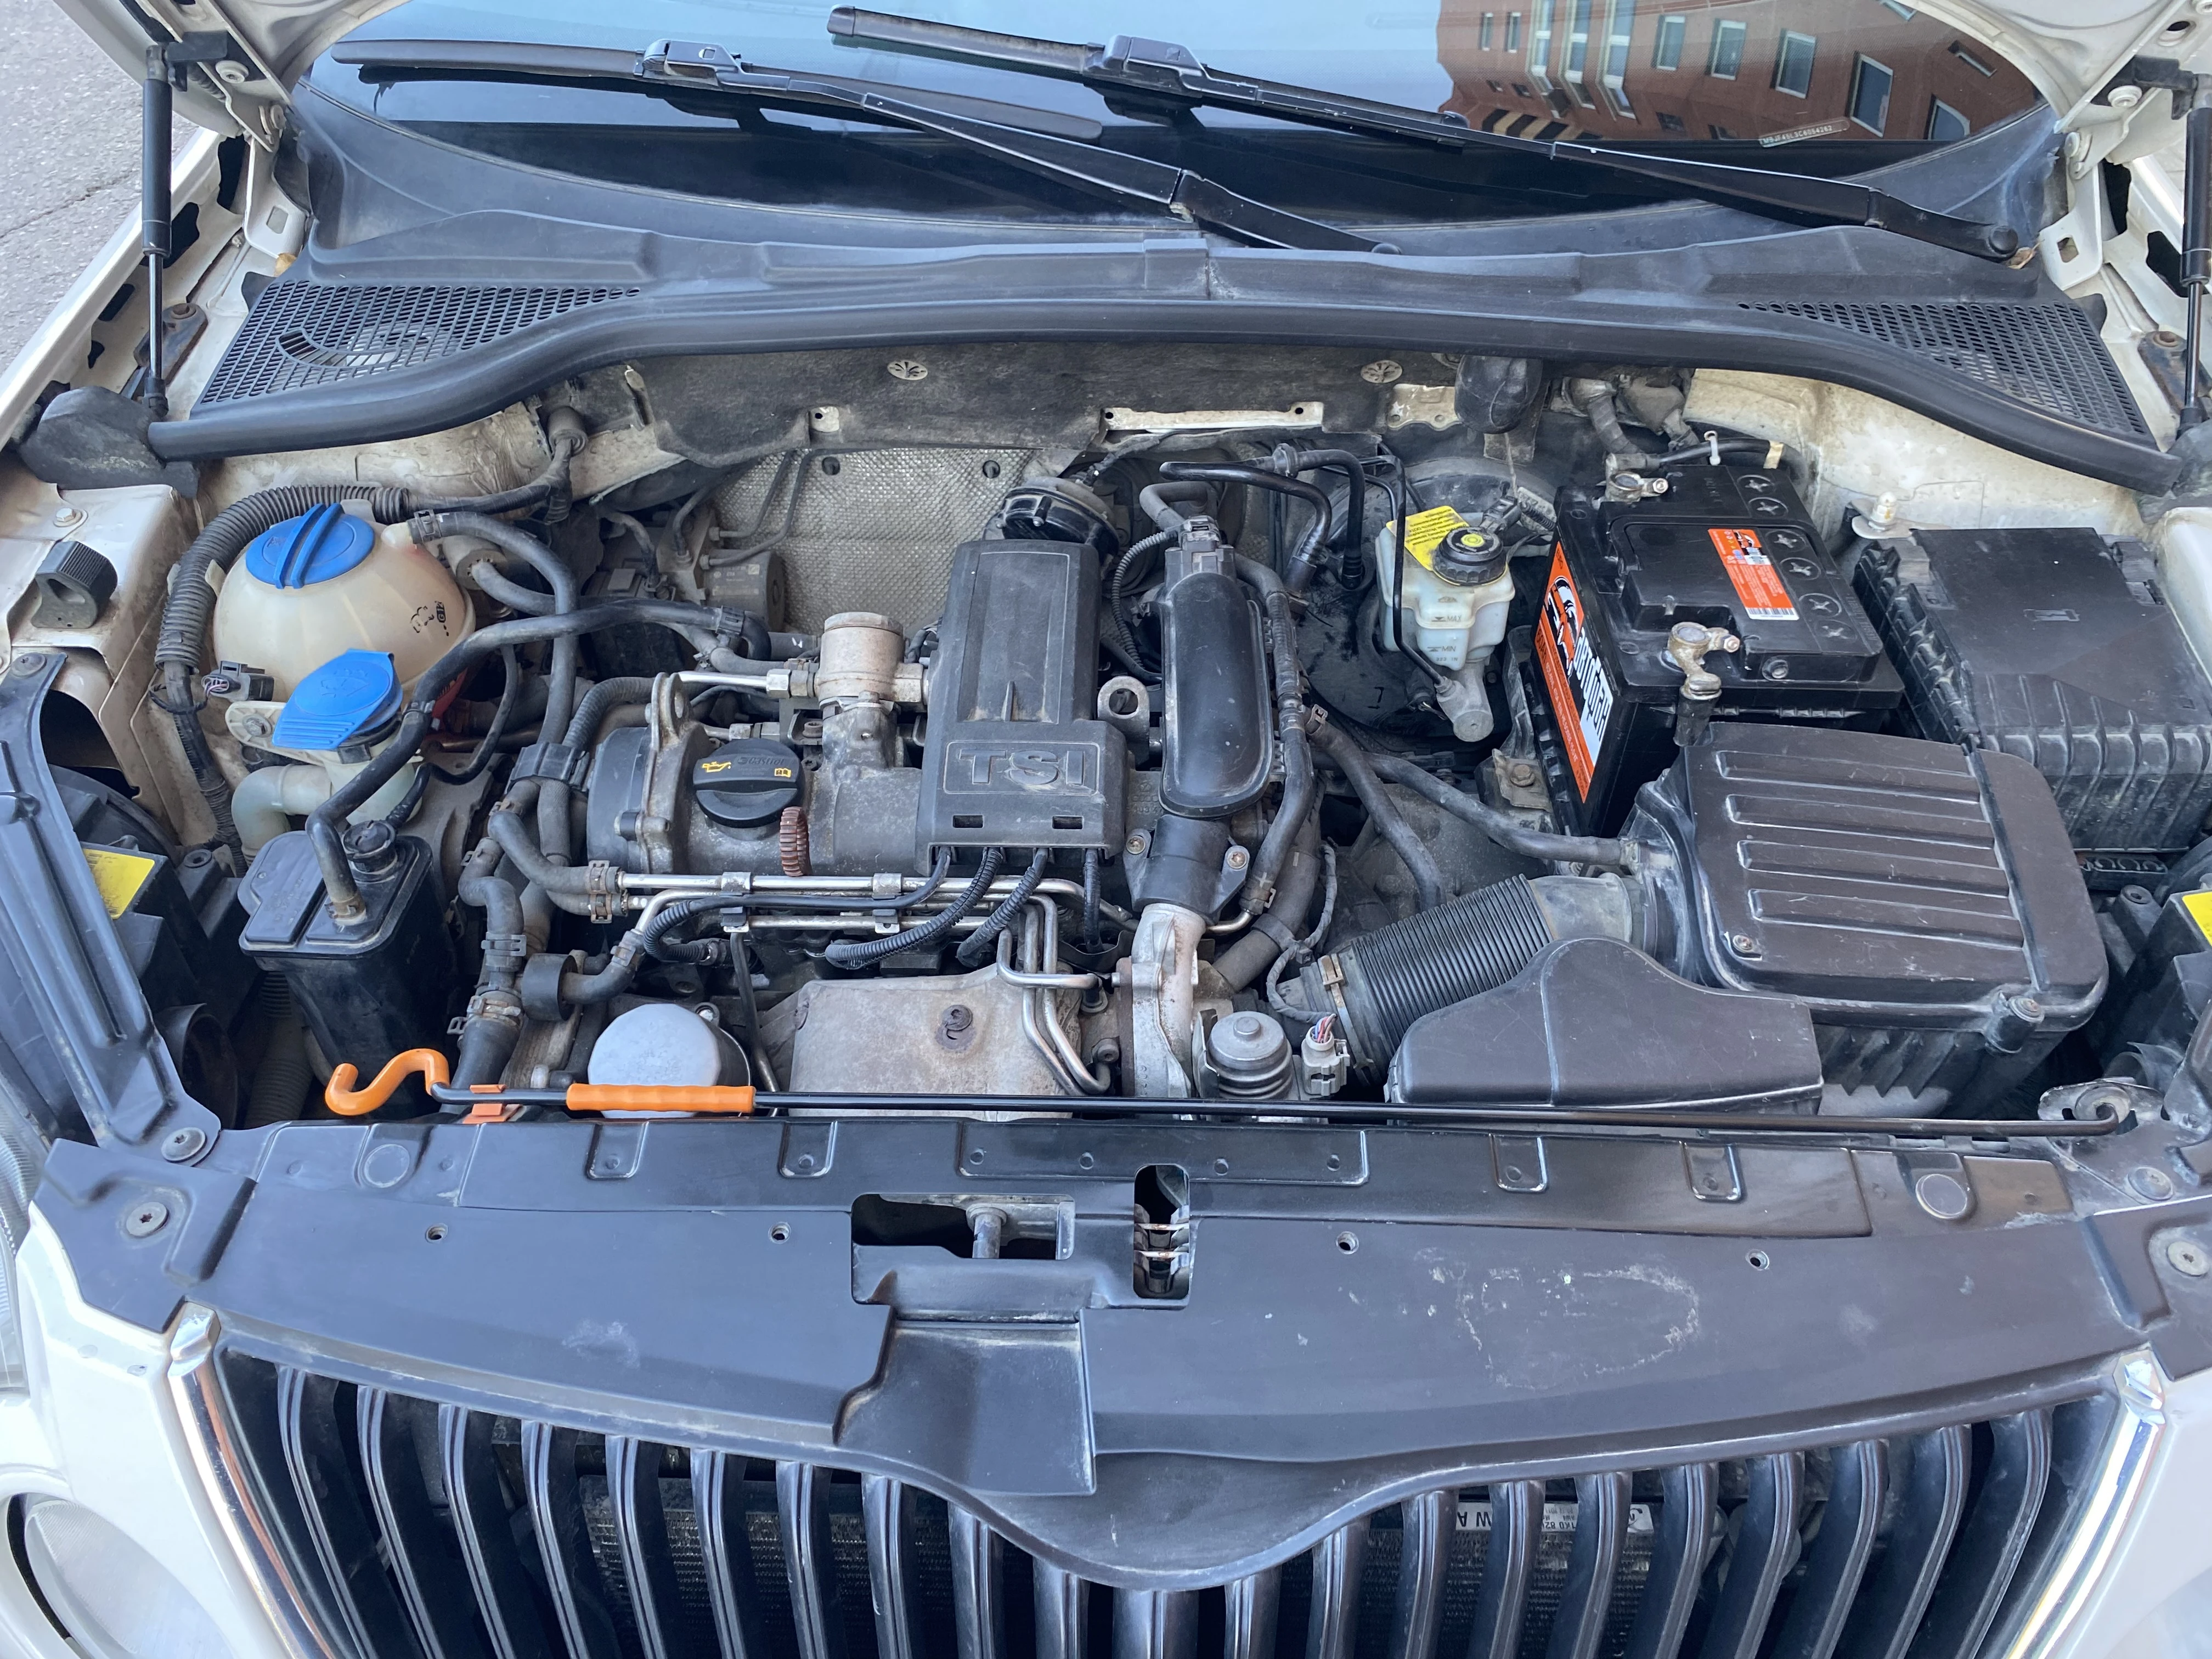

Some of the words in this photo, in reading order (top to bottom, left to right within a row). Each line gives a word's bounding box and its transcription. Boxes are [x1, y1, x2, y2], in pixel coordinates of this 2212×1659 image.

[1447, 614, 1462, 623] MAX
[748, 755, 785, 766] Castrol
[959, 749, 1086, 786] TSI
